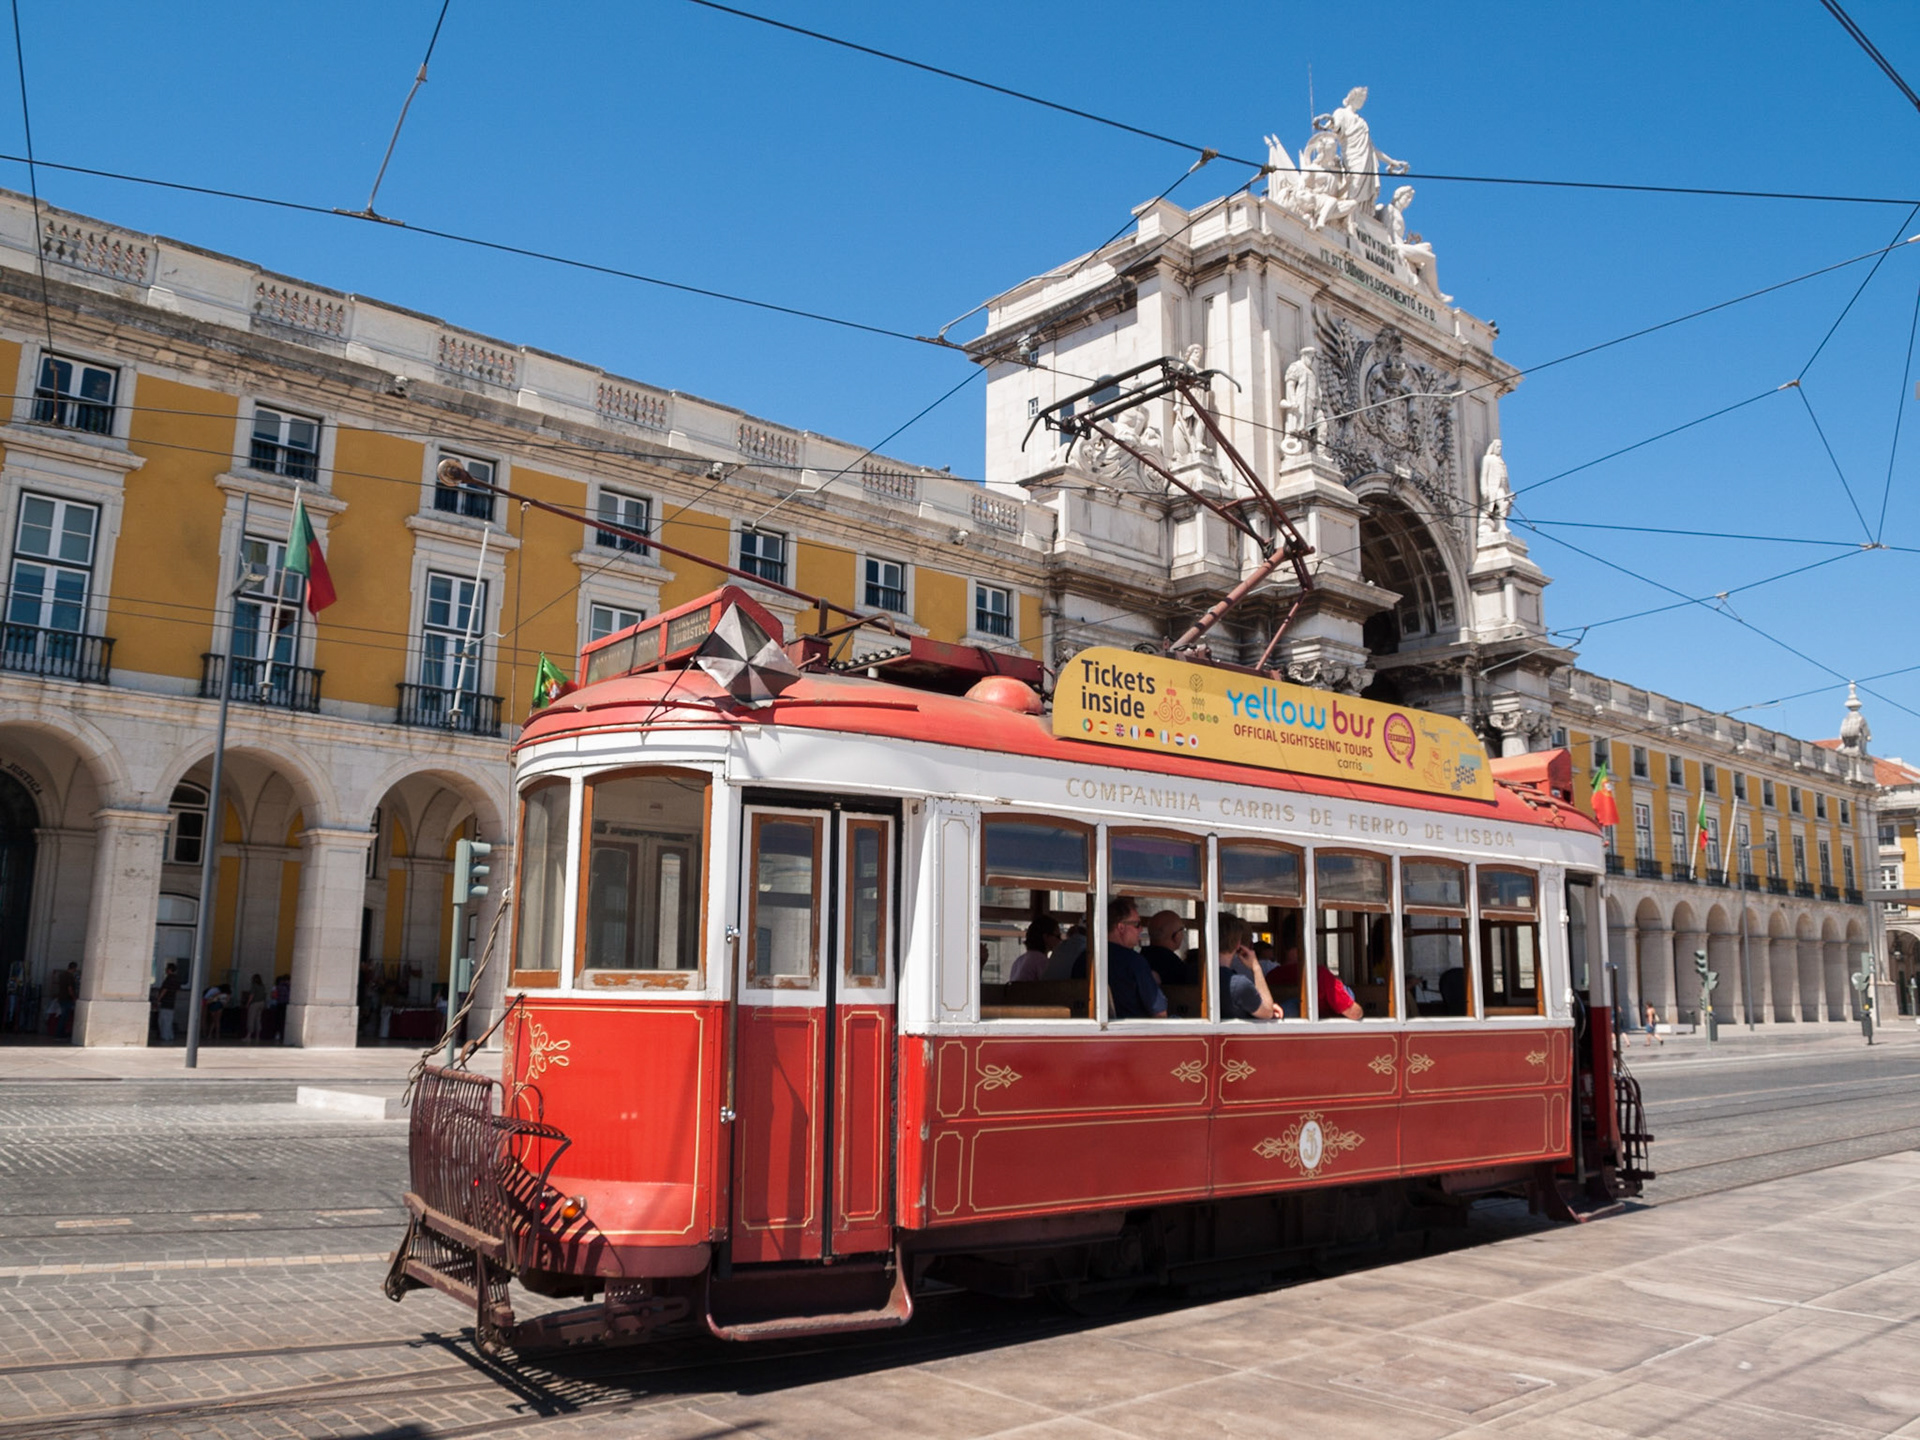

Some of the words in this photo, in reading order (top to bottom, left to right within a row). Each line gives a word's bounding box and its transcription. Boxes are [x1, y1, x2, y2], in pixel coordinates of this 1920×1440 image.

[1081, 659, 1155, 694] Tickets
[1082, 686, 1145, 719] inside
[1332, 700, 1375, 739] bus
[1233, 723, 1278, 743] OFFICIAL
[1280, 731, 1341, 753] SIGHTSEEING
[1343, 743, 1374, 758] TOURS
[1337, 758, 1363, 771] carris
[1065, 777, 1201, 812] COMPANHIA
[1219, 797, 1296, 822] CARRIS
[1309, 808, 1333, 826] DE
[1349, 814, 1409, 836] FERRO
[1425, 823, 1444, 840] DE
[1455, 826, 1516, 847] LISBOA
